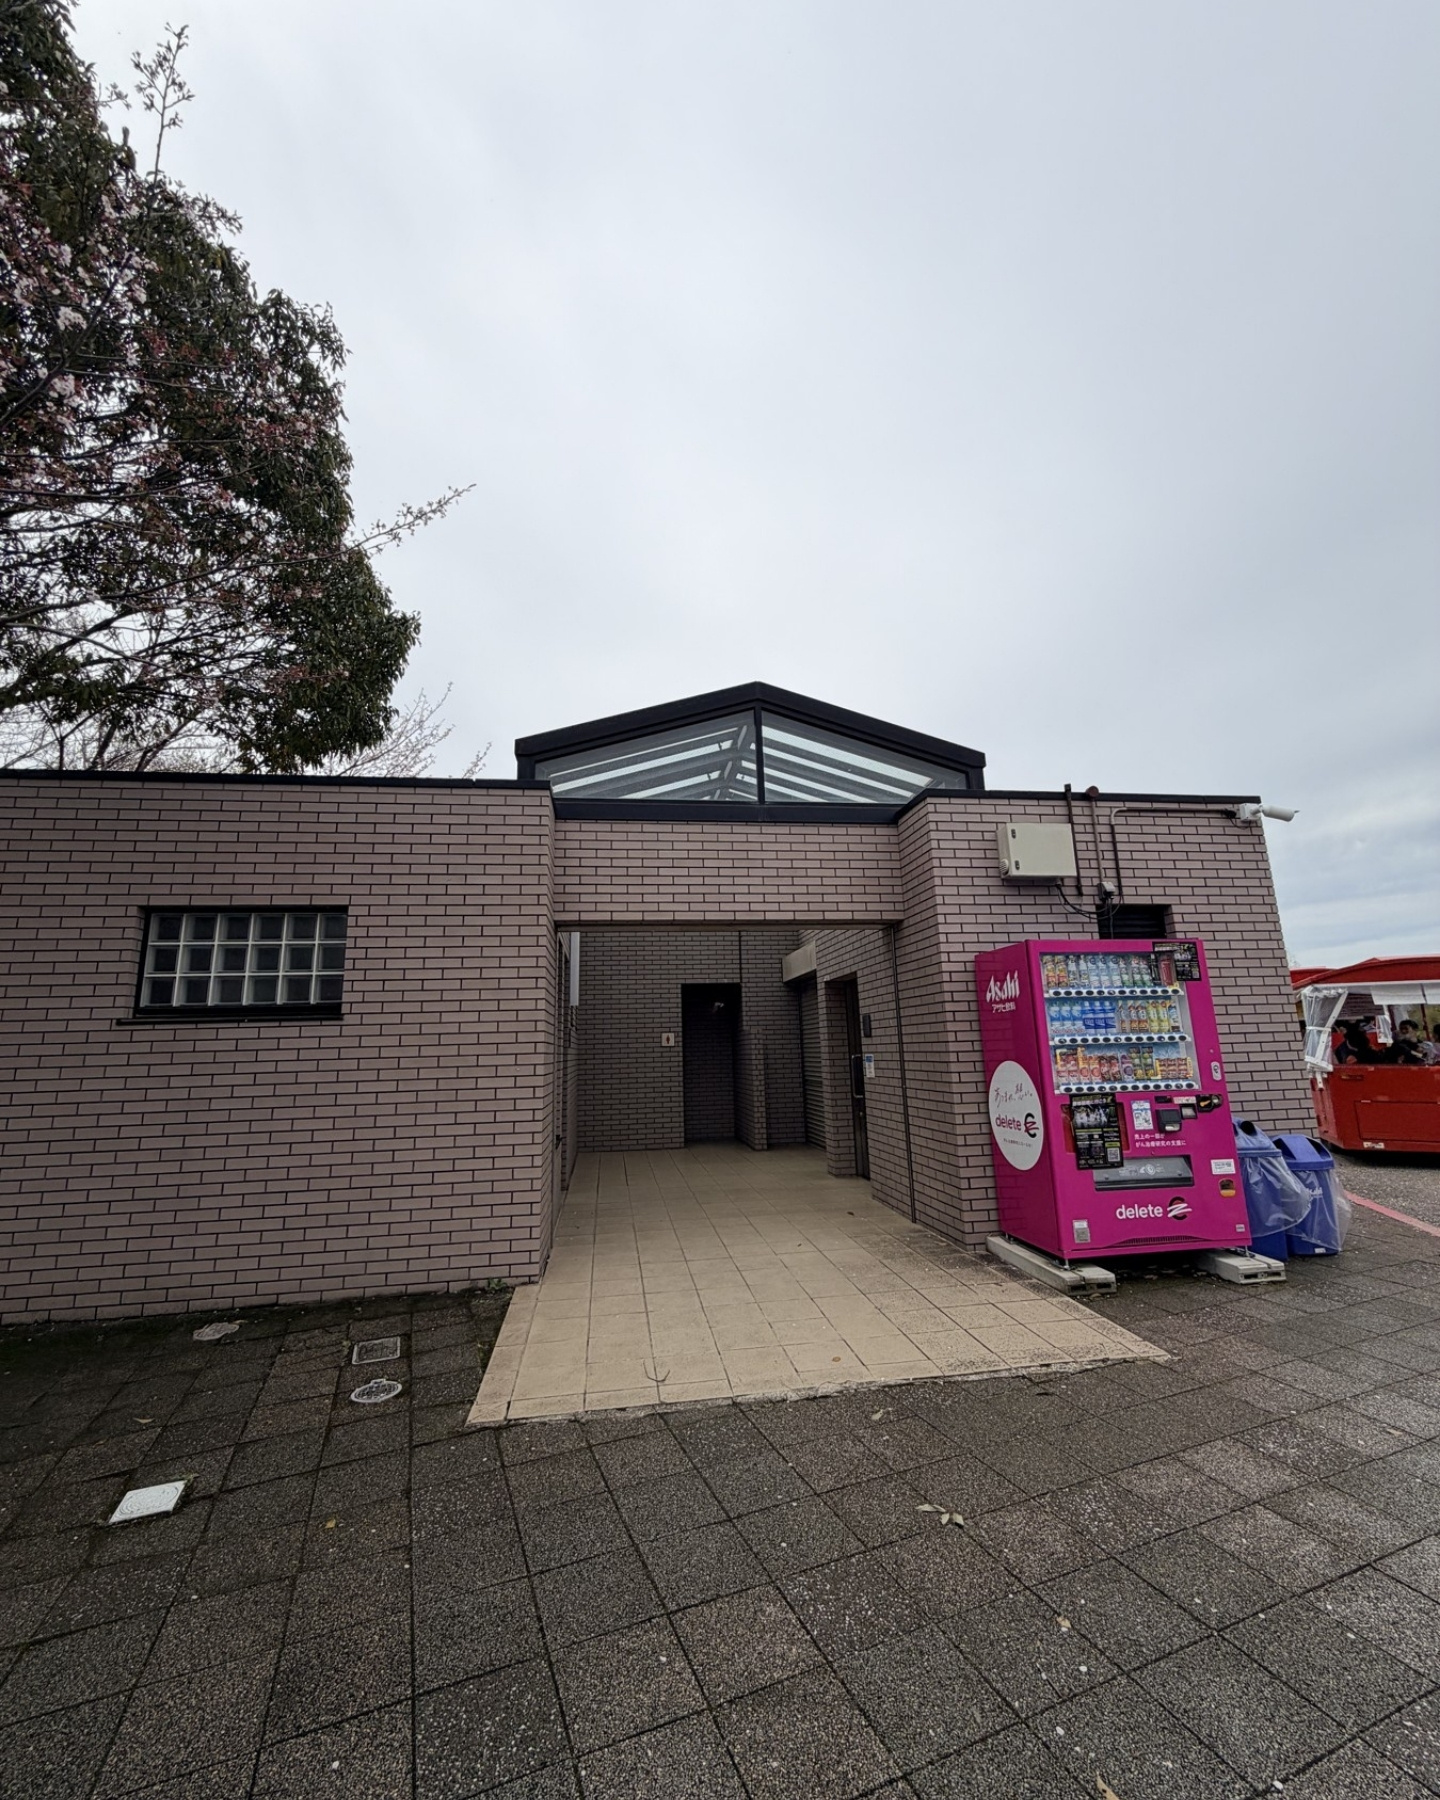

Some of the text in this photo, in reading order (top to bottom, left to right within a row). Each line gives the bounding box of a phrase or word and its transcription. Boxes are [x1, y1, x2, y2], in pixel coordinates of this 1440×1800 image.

[986, 970, 1020, 1003] Asahi
[995, 1114, 1022, 1131] delete
[1115, 1203, 1164, 1220] delete
